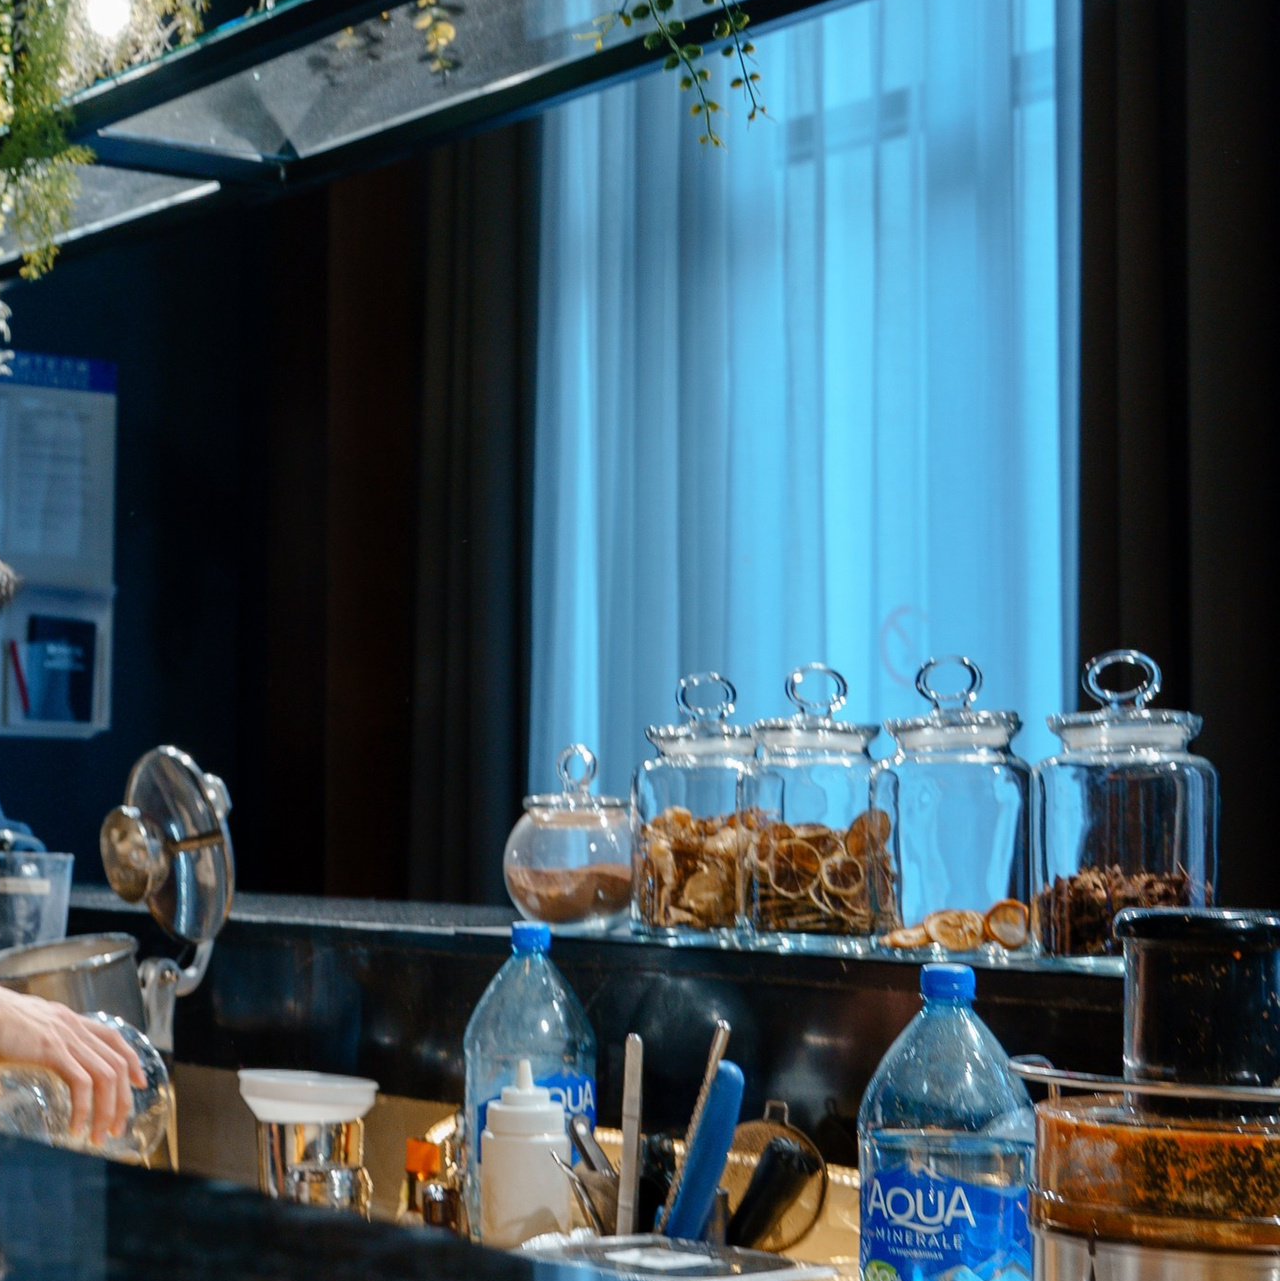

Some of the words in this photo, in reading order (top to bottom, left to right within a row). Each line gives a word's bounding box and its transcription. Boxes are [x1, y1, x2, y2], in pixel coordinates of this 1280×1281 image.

[549, 1080, 595, 1114] QUA
[867, 1178, 977, 1234] AQUA
[875, 1226, 963, 1251] MINERALE
